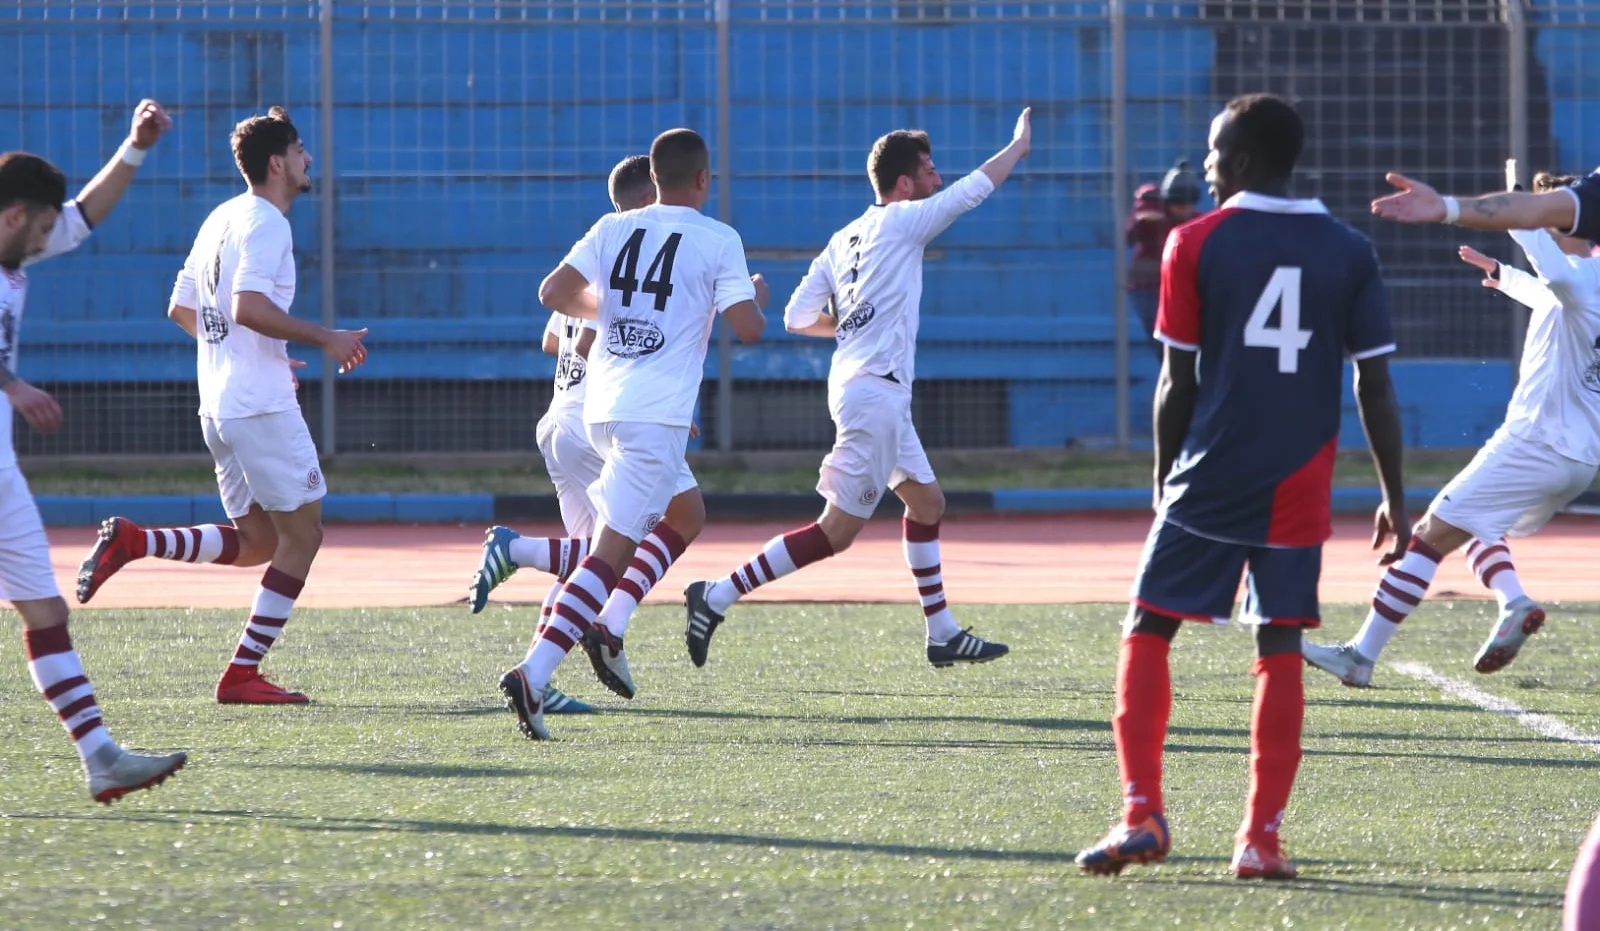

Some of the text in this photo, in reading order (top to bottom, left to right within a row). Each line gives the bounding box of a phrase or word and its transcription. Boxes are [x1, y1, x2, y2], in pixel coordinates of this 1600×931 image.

[609, 228, 683, 312] 44
[618, 325, 658, 350] Vena
[1243, 265, 1314, 373] 4
